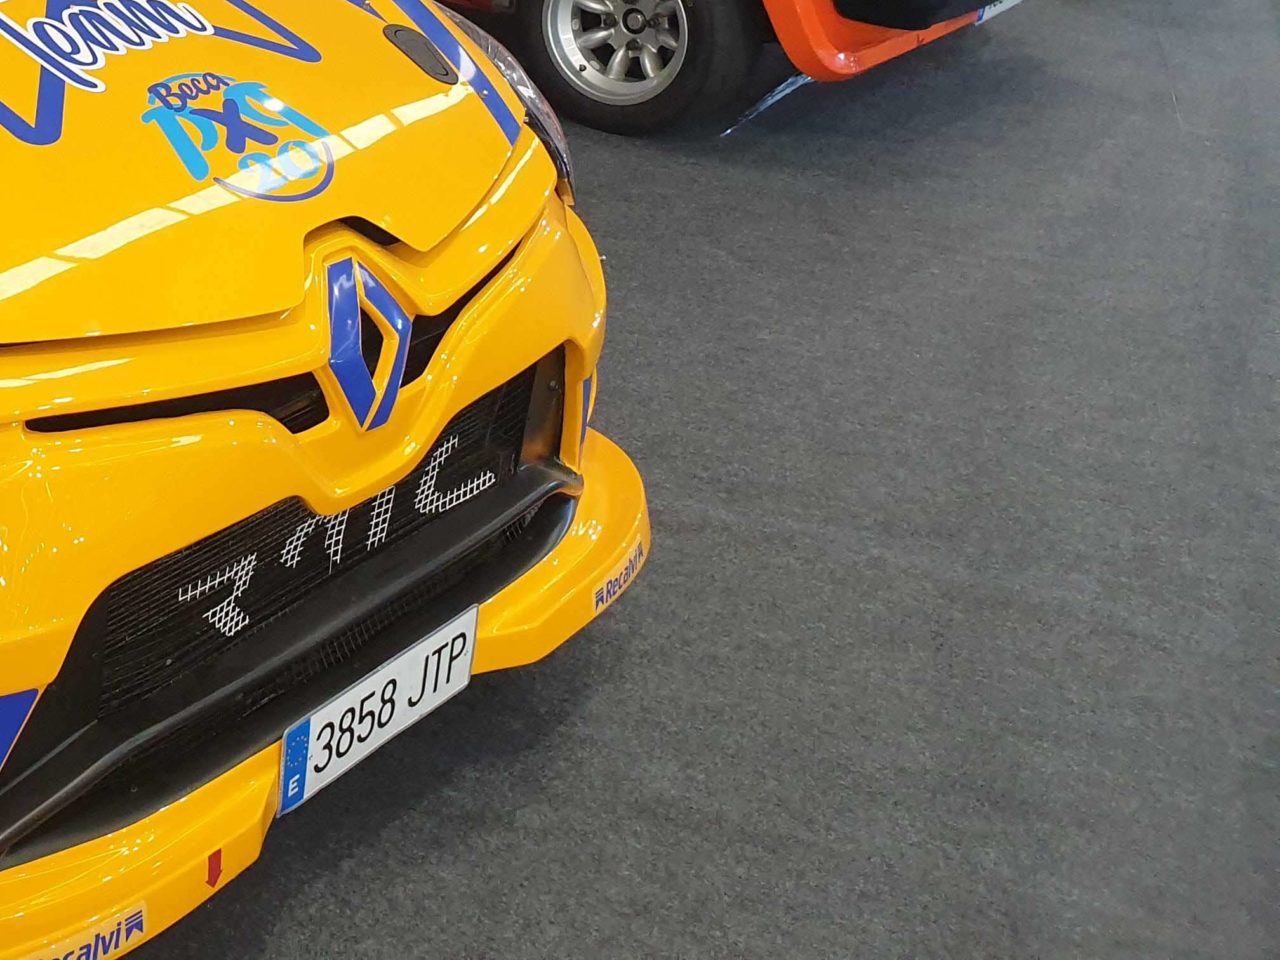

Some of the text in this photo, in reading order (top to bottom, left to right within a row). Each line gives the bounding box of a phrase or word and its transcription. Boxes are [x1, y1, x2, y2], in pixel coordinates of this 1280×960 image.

[605, 548, 638, 604] Recalvi
[313, 631, 468, 774] 3858 JTP
[287, 773, 301, 798] E
